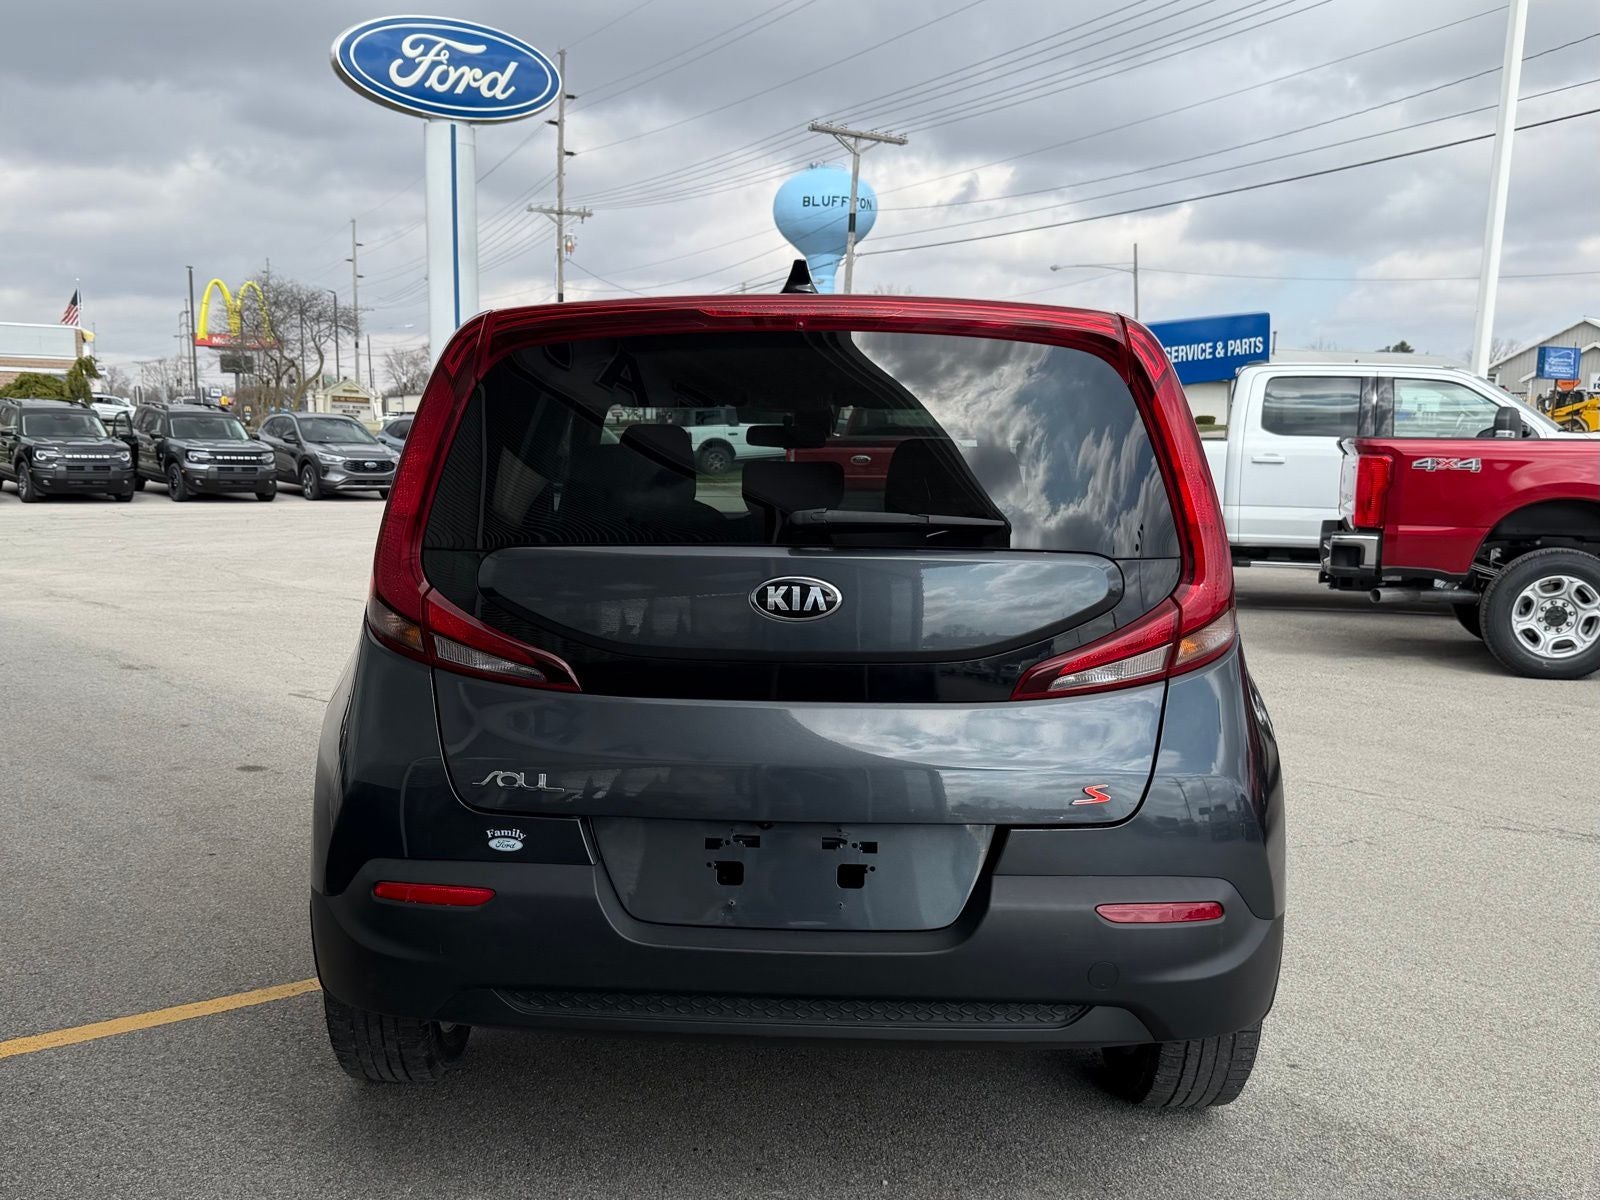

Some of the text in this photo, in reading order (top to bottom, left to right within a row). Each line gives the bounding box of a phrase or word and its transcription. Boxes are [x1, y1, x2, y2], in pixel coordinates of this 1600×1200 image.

[388, 33, 518, 100] Ford
[1165, 336, 1264, 363] SERVICE & PARTS
[766, 585, 827, 611] KIA
[471, 770, 565, 792] SOUL
[1070, 783, 1111, 805] S
[485, 829, 527, 841] Family
[494, 839, 516, 849] Ford
